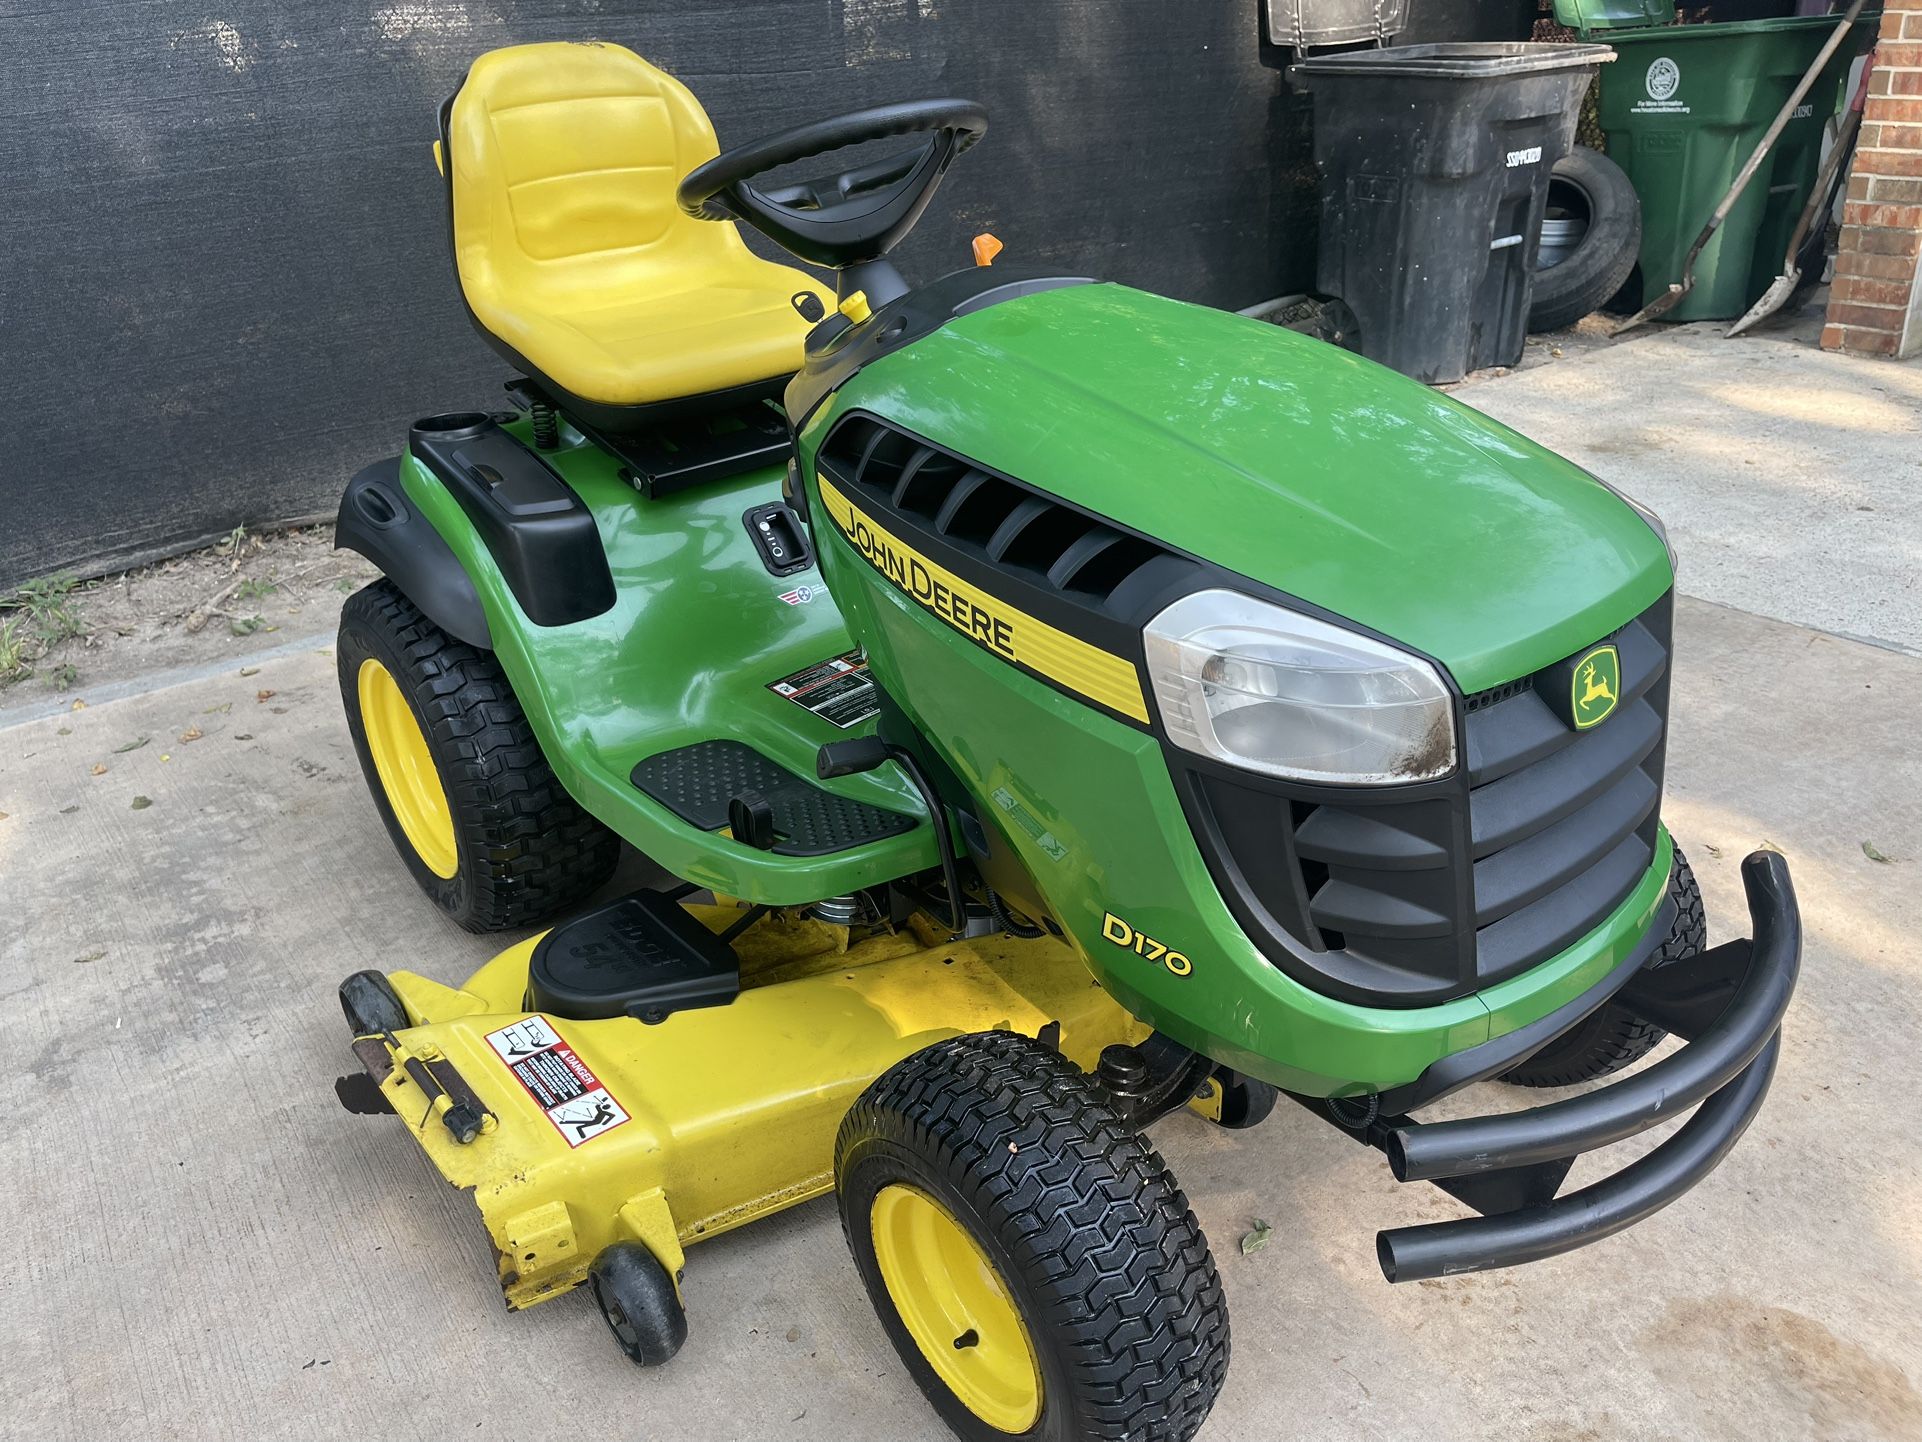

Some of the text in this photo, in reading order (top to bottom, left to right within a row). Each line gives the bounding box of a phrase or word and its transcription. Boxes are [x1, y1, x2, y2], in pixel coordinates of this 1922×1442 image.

[846, 507, 1016, 658] JOHN DEERE
[1102, 911, 1193, 977] D170
[566, 1054, 595, 1085] DANGER
